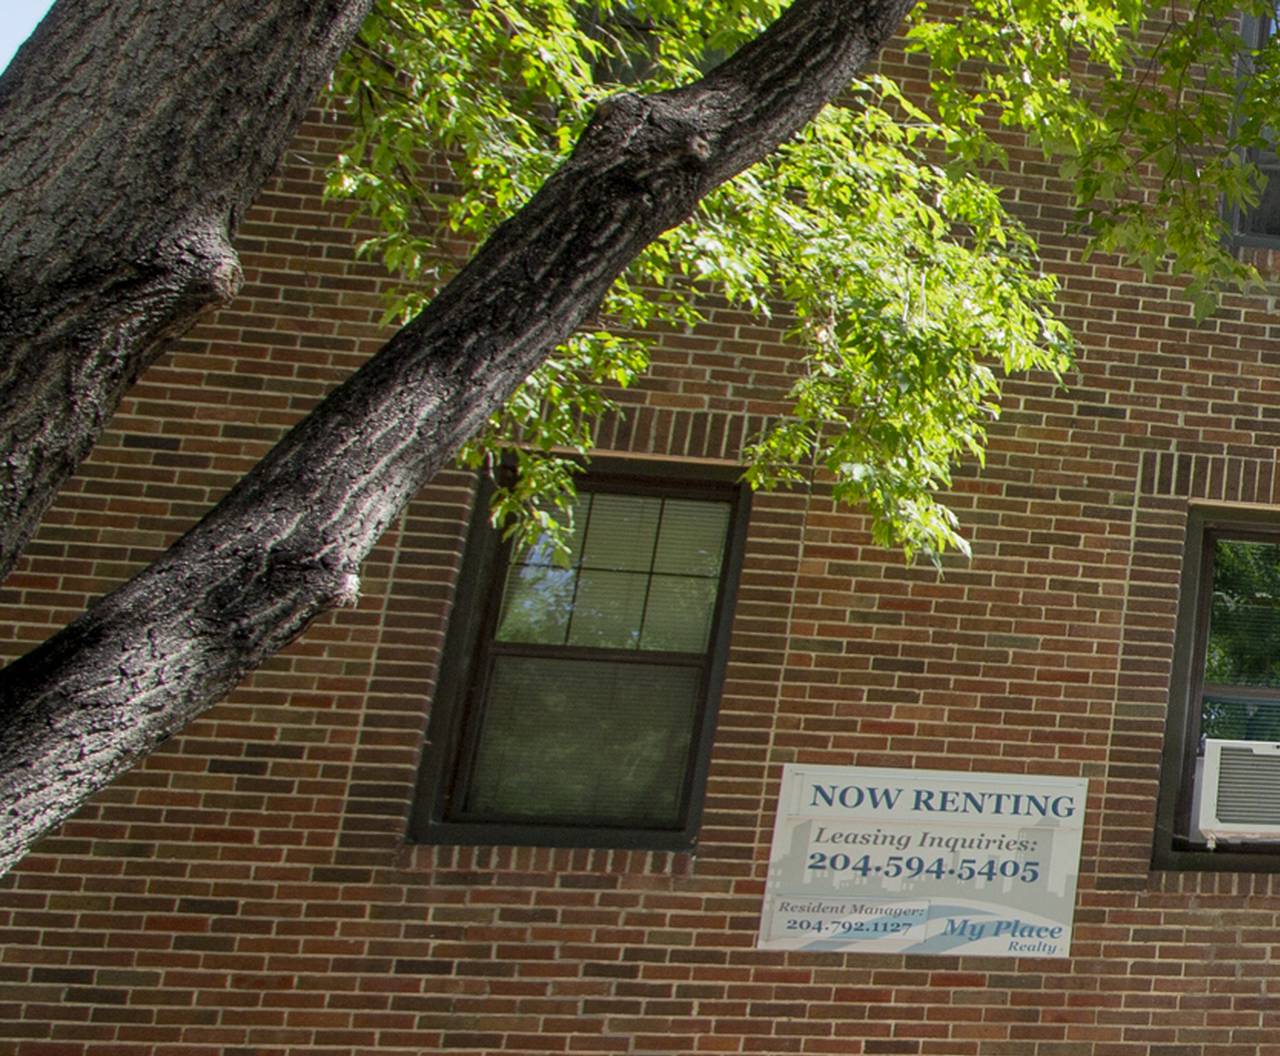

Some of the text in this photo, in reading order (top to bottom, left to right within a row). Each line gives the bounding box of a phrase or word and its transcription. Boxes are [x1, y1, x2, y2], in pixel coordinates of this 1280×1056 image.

[809, 783, 1076, 818] NOW RENTING
[813, 826, 1038, 853] Leasing Inquiries:
[778, 901, 925, 919] Resident Manager:
[786, 919, 913, 937] 204.792.1127
[942, 918, 1063, 941] My Place
[1007, 940, 1057, 955] Realty
